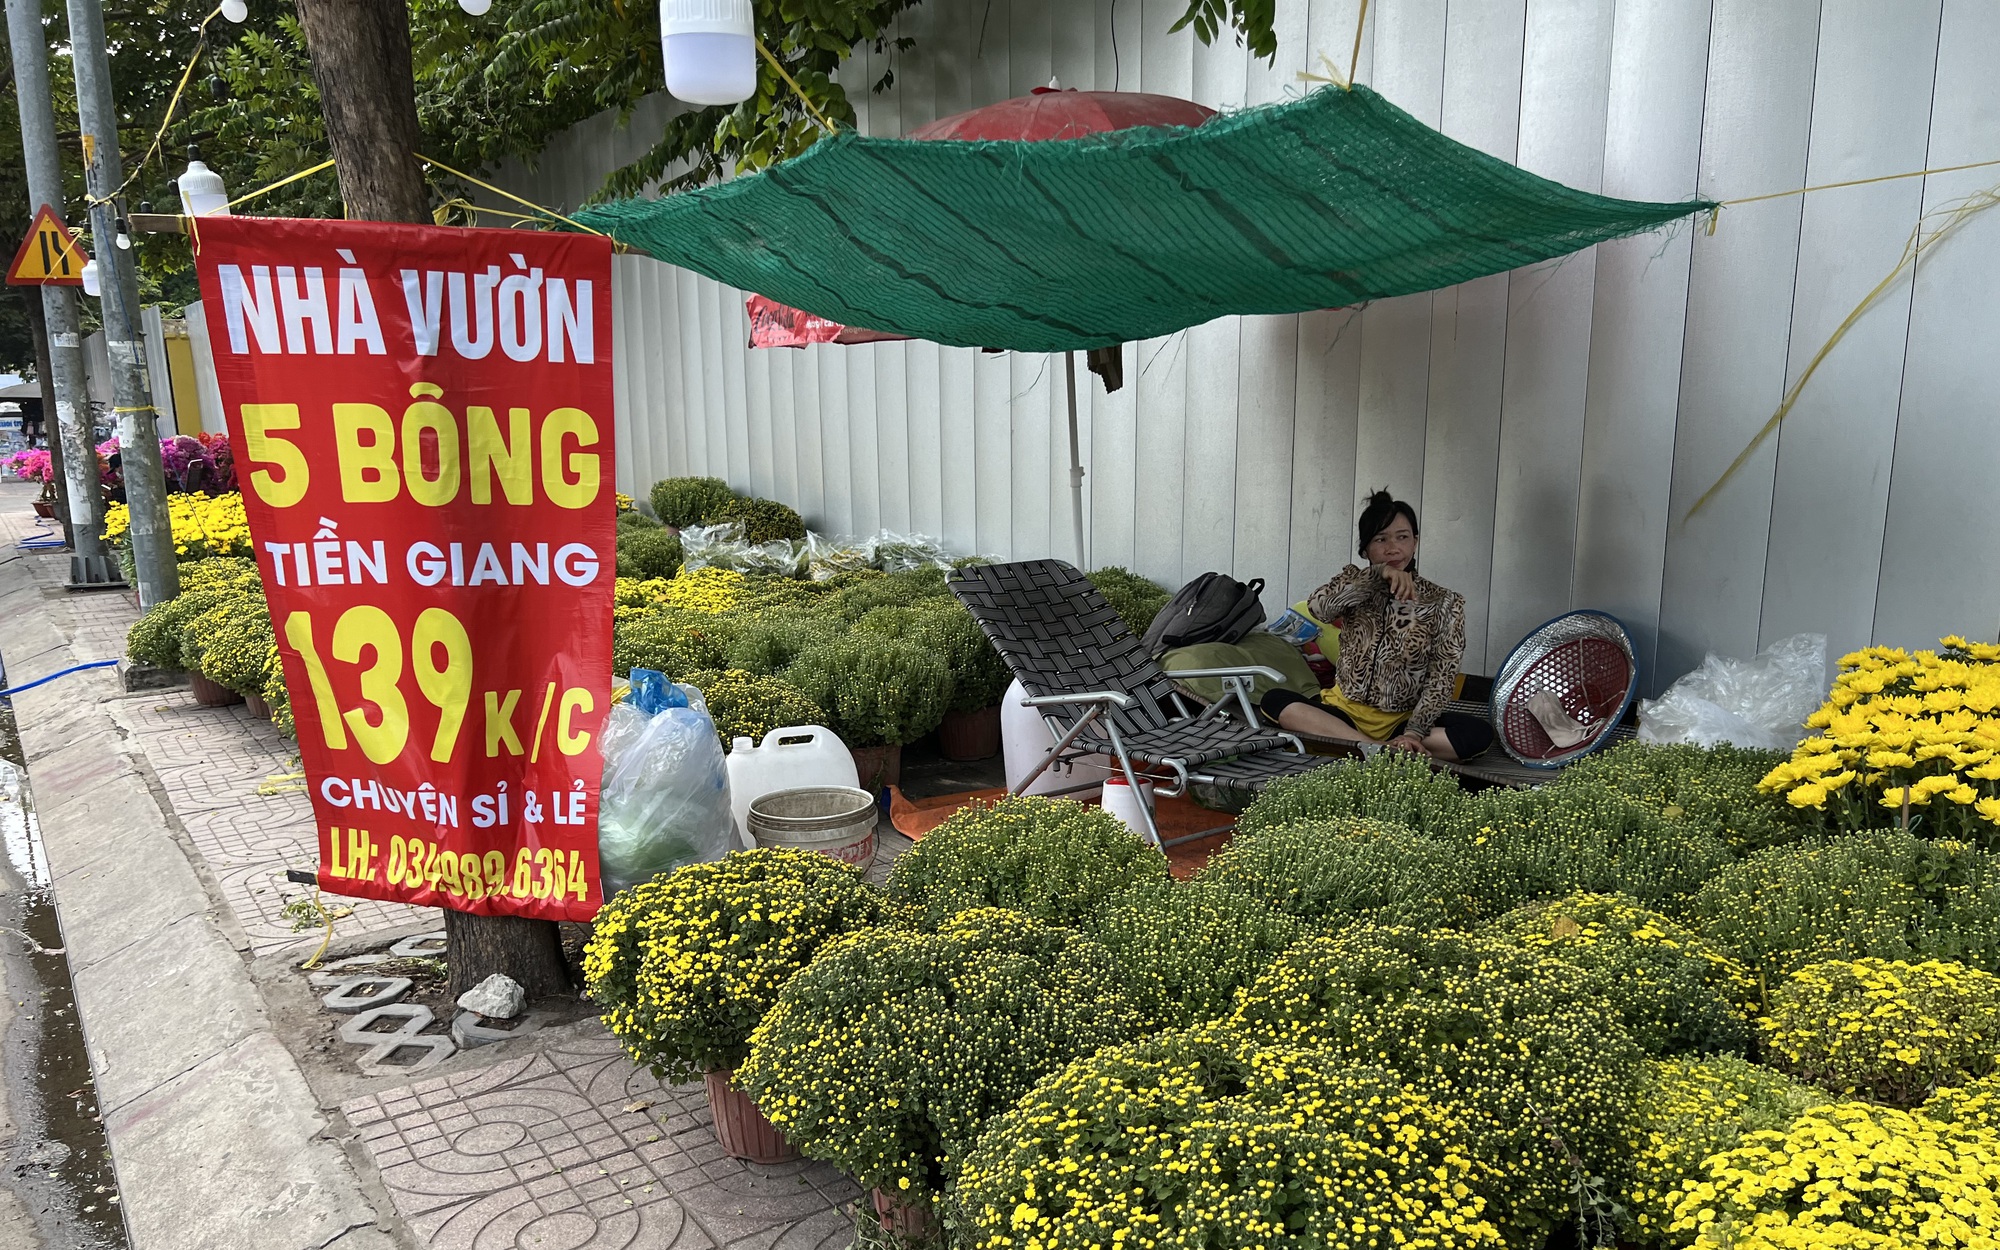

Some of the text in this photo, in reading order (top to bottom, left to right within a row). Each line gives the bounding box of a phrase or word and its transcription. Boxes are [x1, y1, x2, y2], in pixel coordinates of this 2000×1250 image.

[217, 249, 595, 364] NHÀ VƯỜN
[240, 382, 601, 510] 5 BÔNG
[264, 516, 600, 587] TIỀN GIANG
[284, 604, 474, 765] 139
[320, 776, 588, 829] CHUYÊN SỈ & LẺ
[329, 826, 379, 882] LH:
